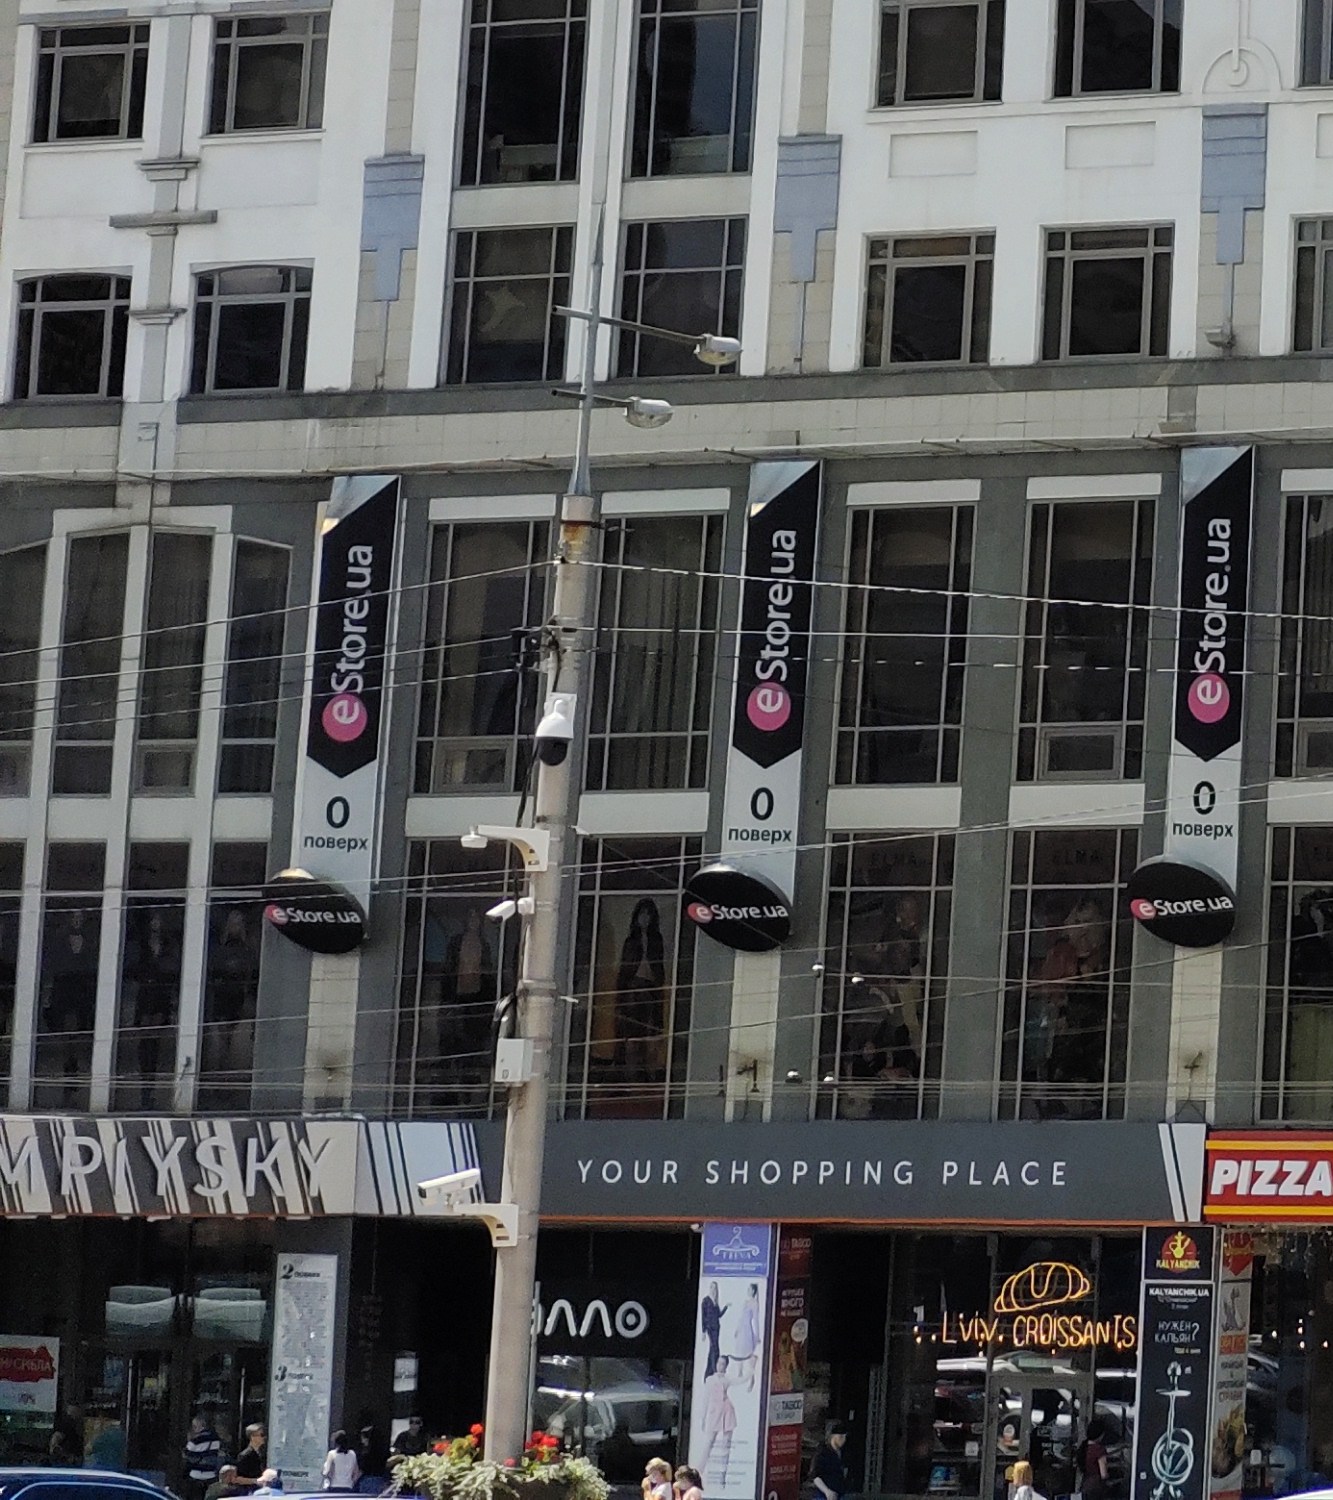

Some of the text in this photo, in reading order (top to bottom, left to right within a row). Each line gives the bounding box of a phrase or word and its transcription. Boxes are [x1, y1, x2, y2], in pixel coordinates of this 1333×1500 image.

[755, 528, 796, 714] eStore.ua
[1195, 516, 1232, 705] eStore.ua
[331, 545, 373, 724] eStore.ua
[728, 826, 792, 845] поверх
[1172, 820, 1233, 839] поверх
[303, 835, 369, 853] поверх
[272, 904, 362, 923] eStore.ua
[696, 900, 789, 921] eStore.ua
[1138, 894, 1233, 917] eStore.ua
[578, 1159, 1067, 1186] YOUR SHOPPING PLACE
[1211, 1160, 1333, 1196] PIZZA
[1149, 1287, 1209, 1297] KALYANCHIK.UA
[1013, 1314, 1135, 1347] CROISSANTS
[1158, 1320, 1191, 1332] НУЖЕН
